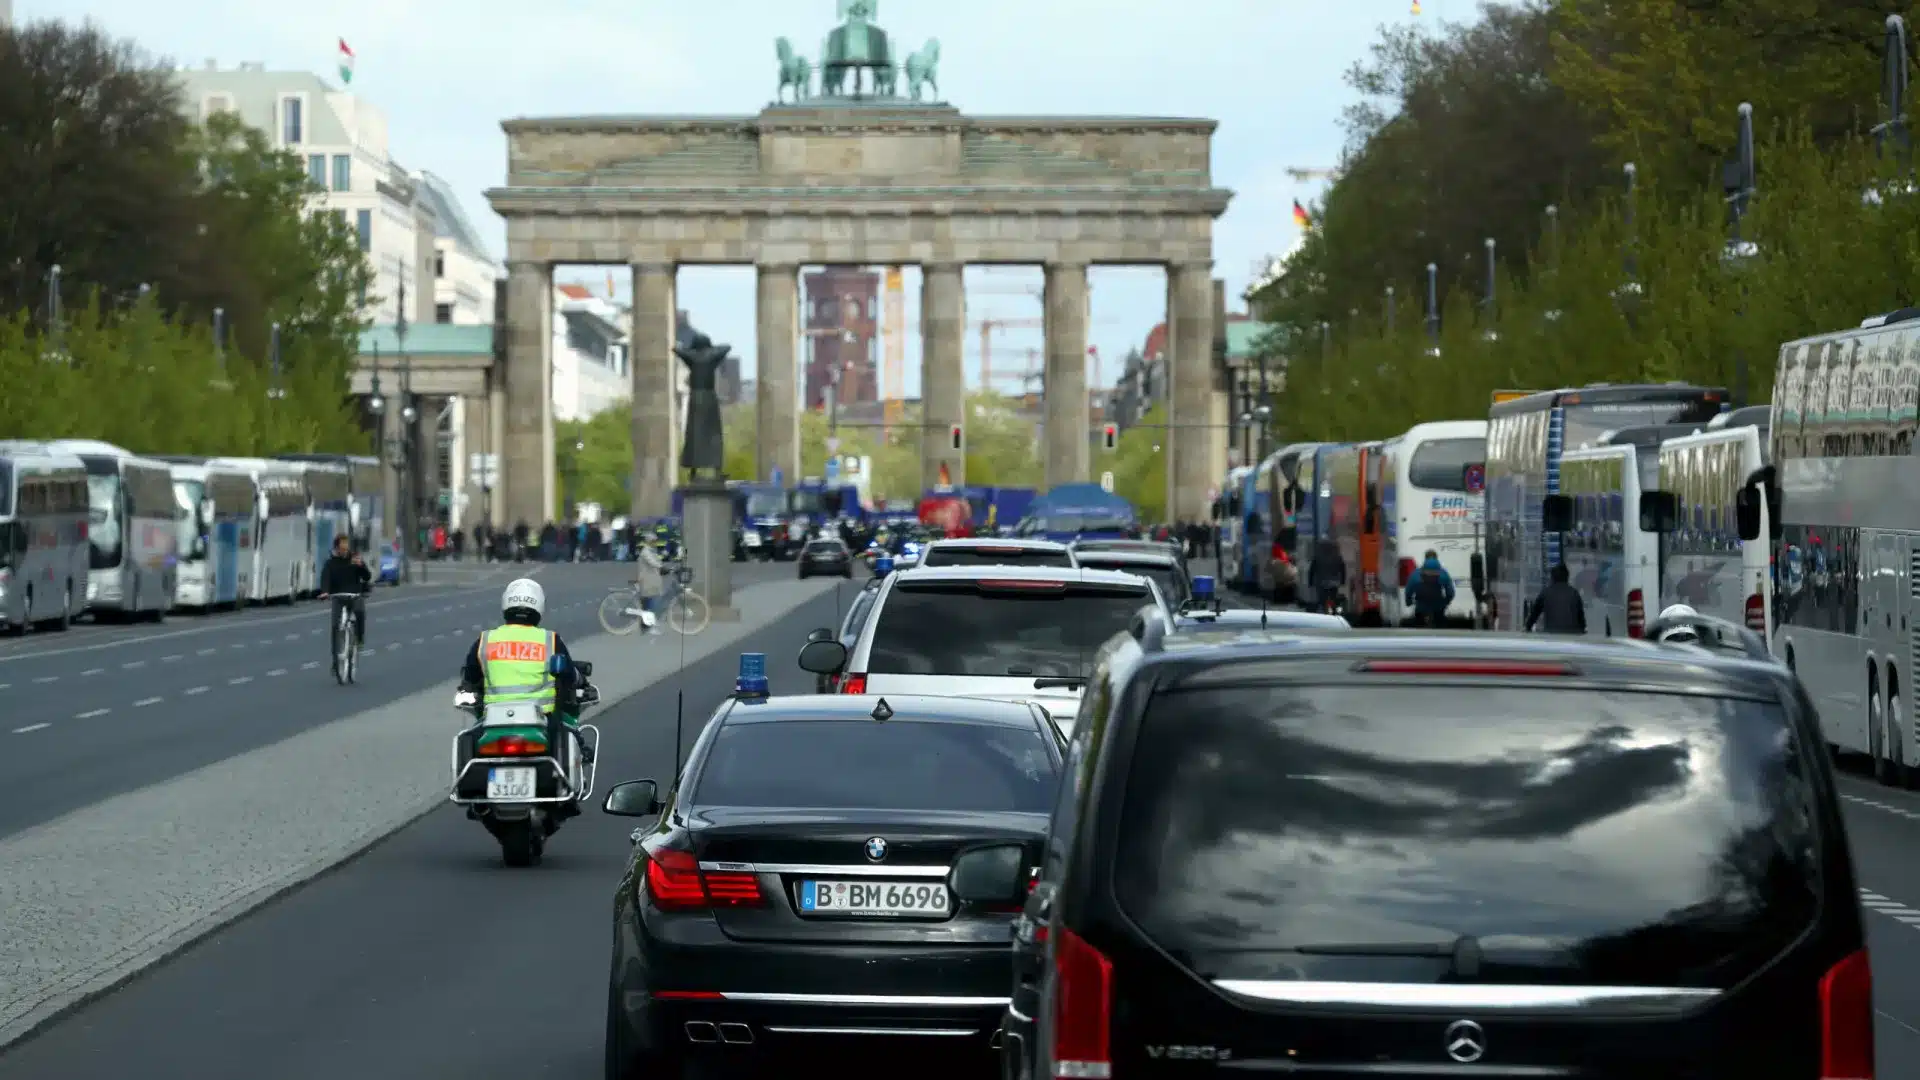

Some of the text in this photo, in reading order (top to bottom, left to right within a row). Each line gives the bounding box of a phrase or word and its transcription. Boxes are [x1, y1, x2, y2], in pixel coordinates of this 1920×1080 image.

[507, 595, 538, 605] POLIZEI
[487, 642, 544, 660] POLIZEI
[816, 884, 946, 909] B BM 6696
